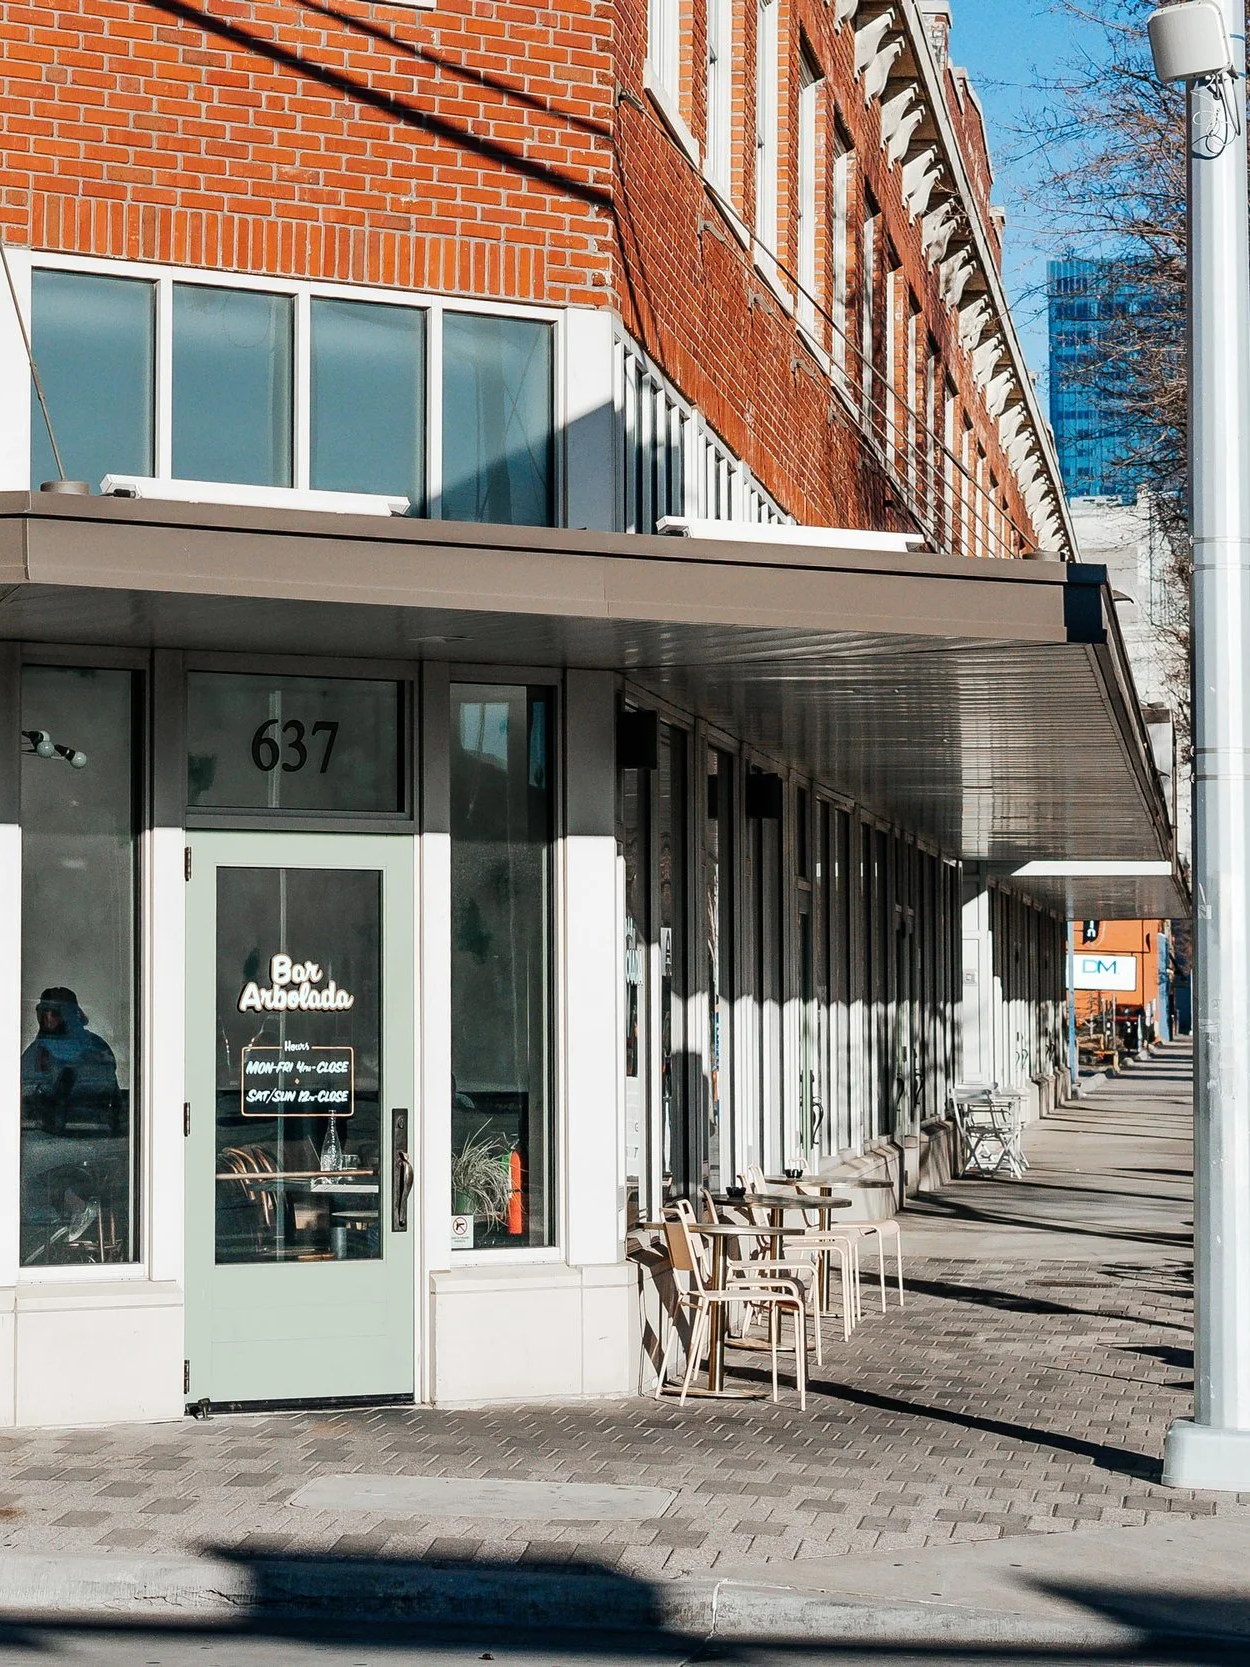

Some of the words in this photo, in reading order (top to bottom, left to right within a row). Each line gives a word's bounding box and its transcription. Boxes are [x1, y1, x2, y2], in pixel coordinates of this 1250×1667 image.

[251, 718, 339, 774] 637
[270, 953, 323, 987] Bar
[1082, 958, 1117, 975] DM
[237, 980, 355, 1012] Arbolada
[284, 1040, 310, 1052] Hours
[246, 1060, 294, 1075] MON-FRI
[245, 1087, 297, 1104] SAT/SUN
